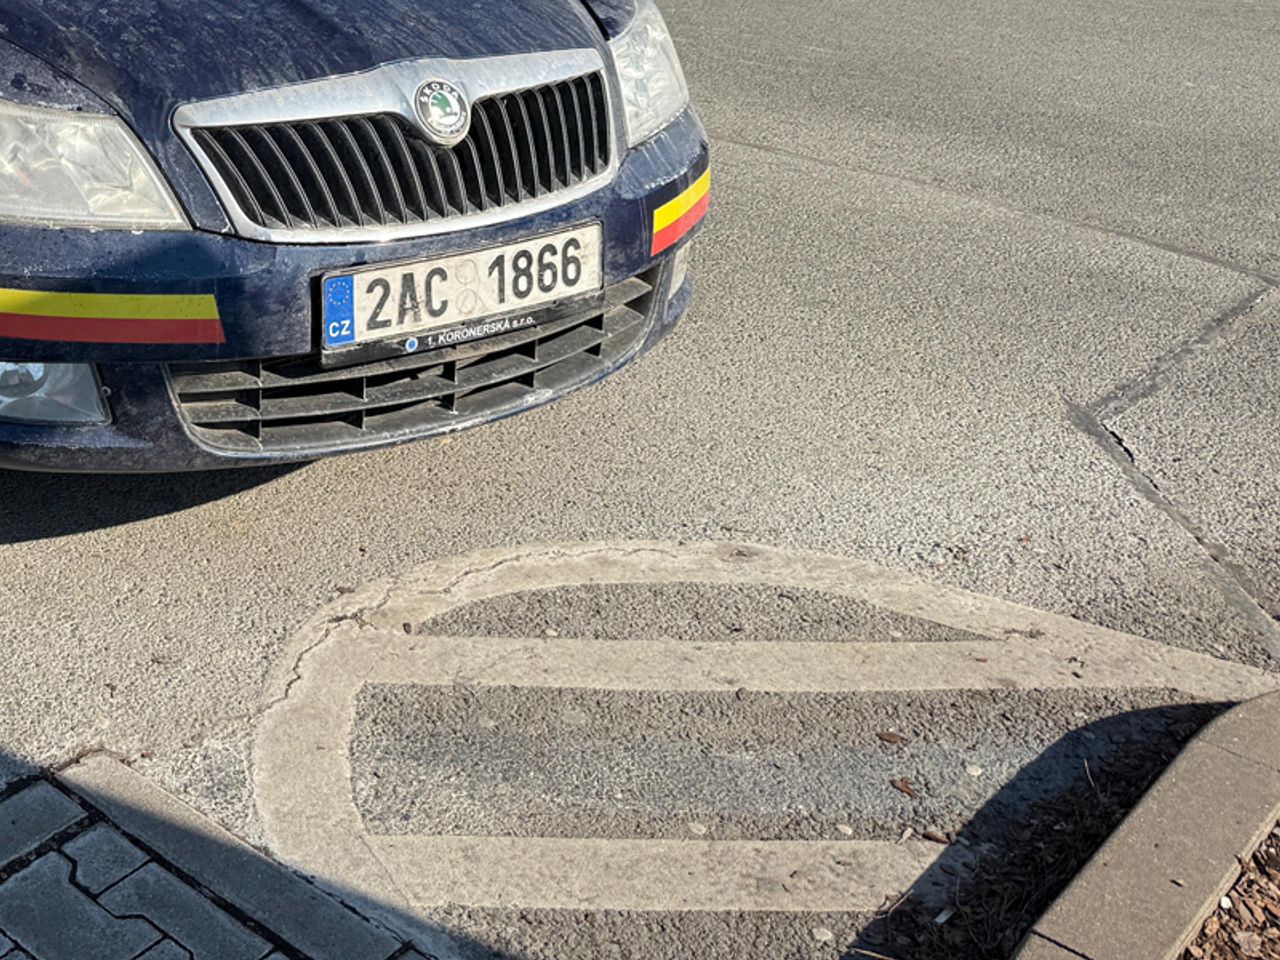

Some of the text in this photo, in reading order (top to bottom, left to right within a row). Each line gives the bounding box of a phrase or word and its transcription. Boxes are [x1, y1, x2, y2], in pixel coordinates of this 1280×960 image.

[366, 237, 581, 331] 2AC 1866
[329, 320, 351, 338] CZ
[427, 316, 536, 347] 1. KORONERSKÁ s.r.o.
